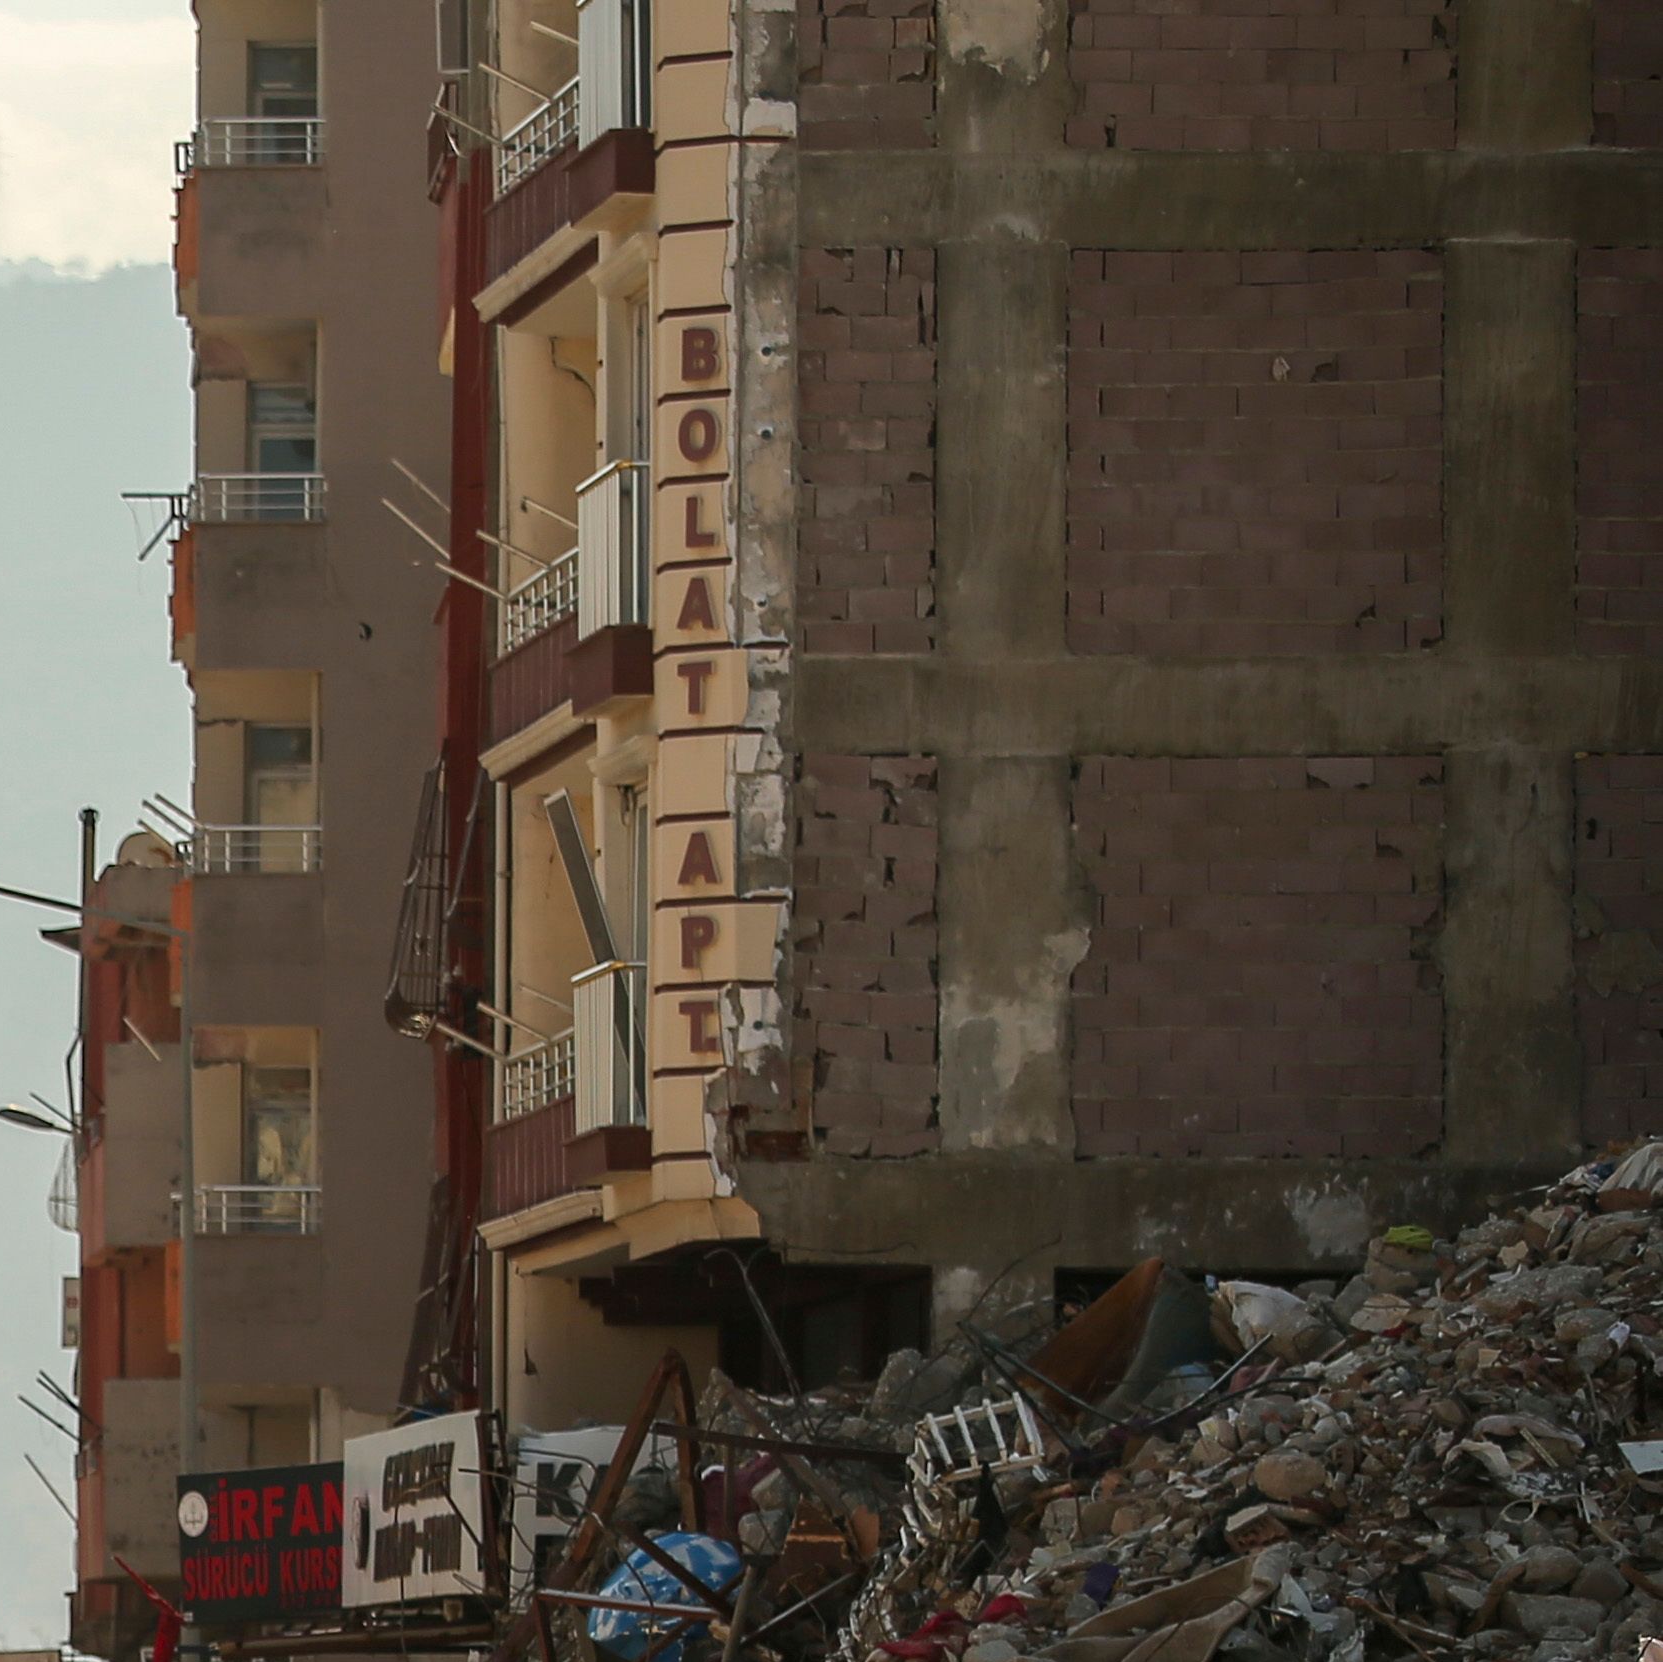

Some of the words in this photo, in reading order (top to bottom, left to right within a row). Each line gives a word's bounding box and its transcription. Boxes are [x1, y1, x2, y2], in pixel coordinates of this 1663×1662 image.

[677, 327, 721, 715] BOLAT
[217, 1478, 344, 1542] İRFAN
[184, 1546, 270, 1600] SÜRÜCÜ
[279, 1547, 343, 1594] KURS
